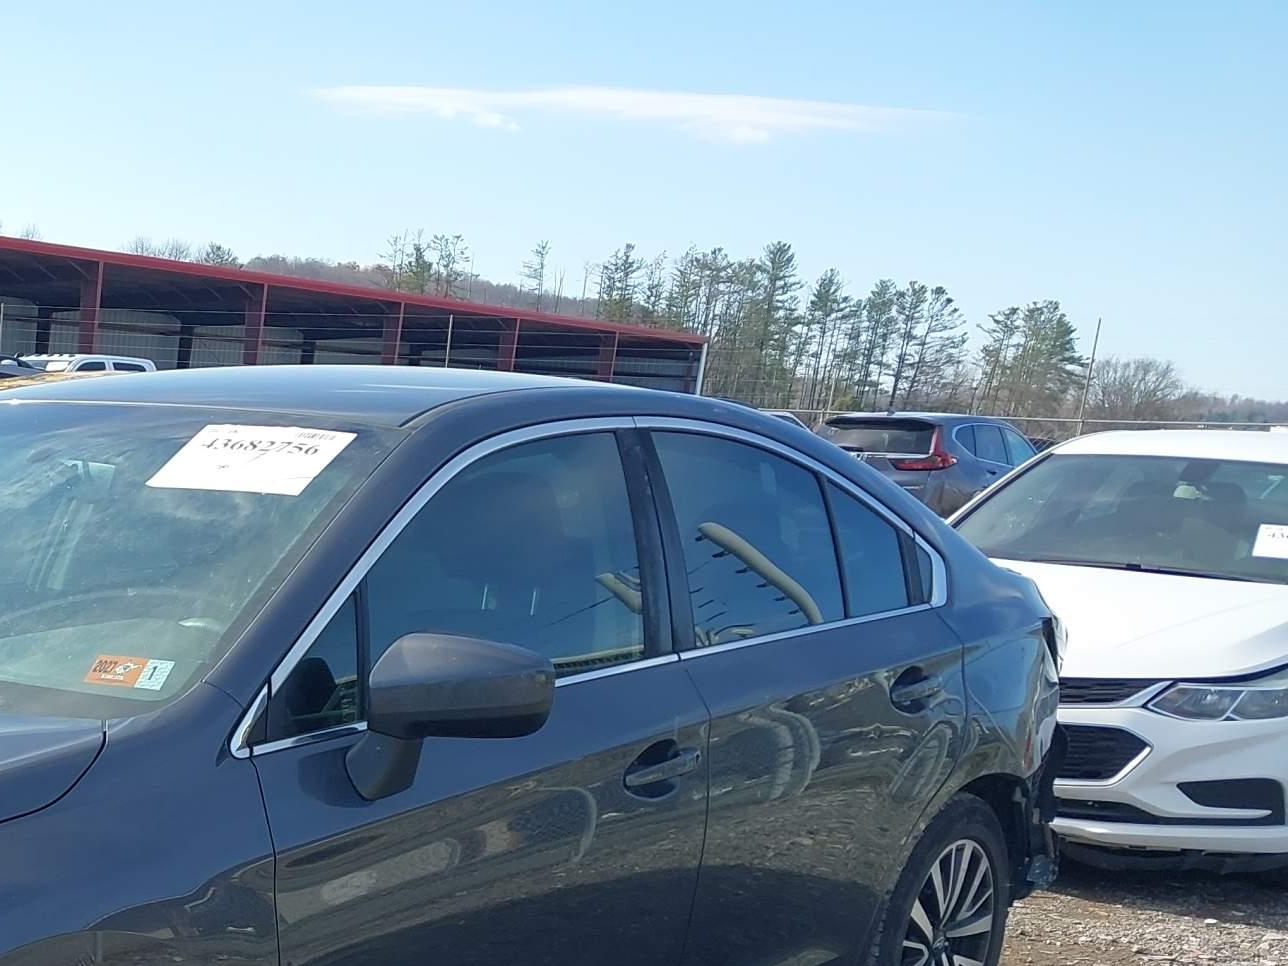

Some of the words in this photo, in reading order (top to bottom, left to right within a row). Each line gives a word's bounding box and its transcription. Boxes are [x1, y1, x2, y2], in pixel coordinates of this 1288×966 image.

[201, 438, 320, 455] 43682756
[93, 660, 118, 673] 2027
[148, 666, 158, 681] 1
